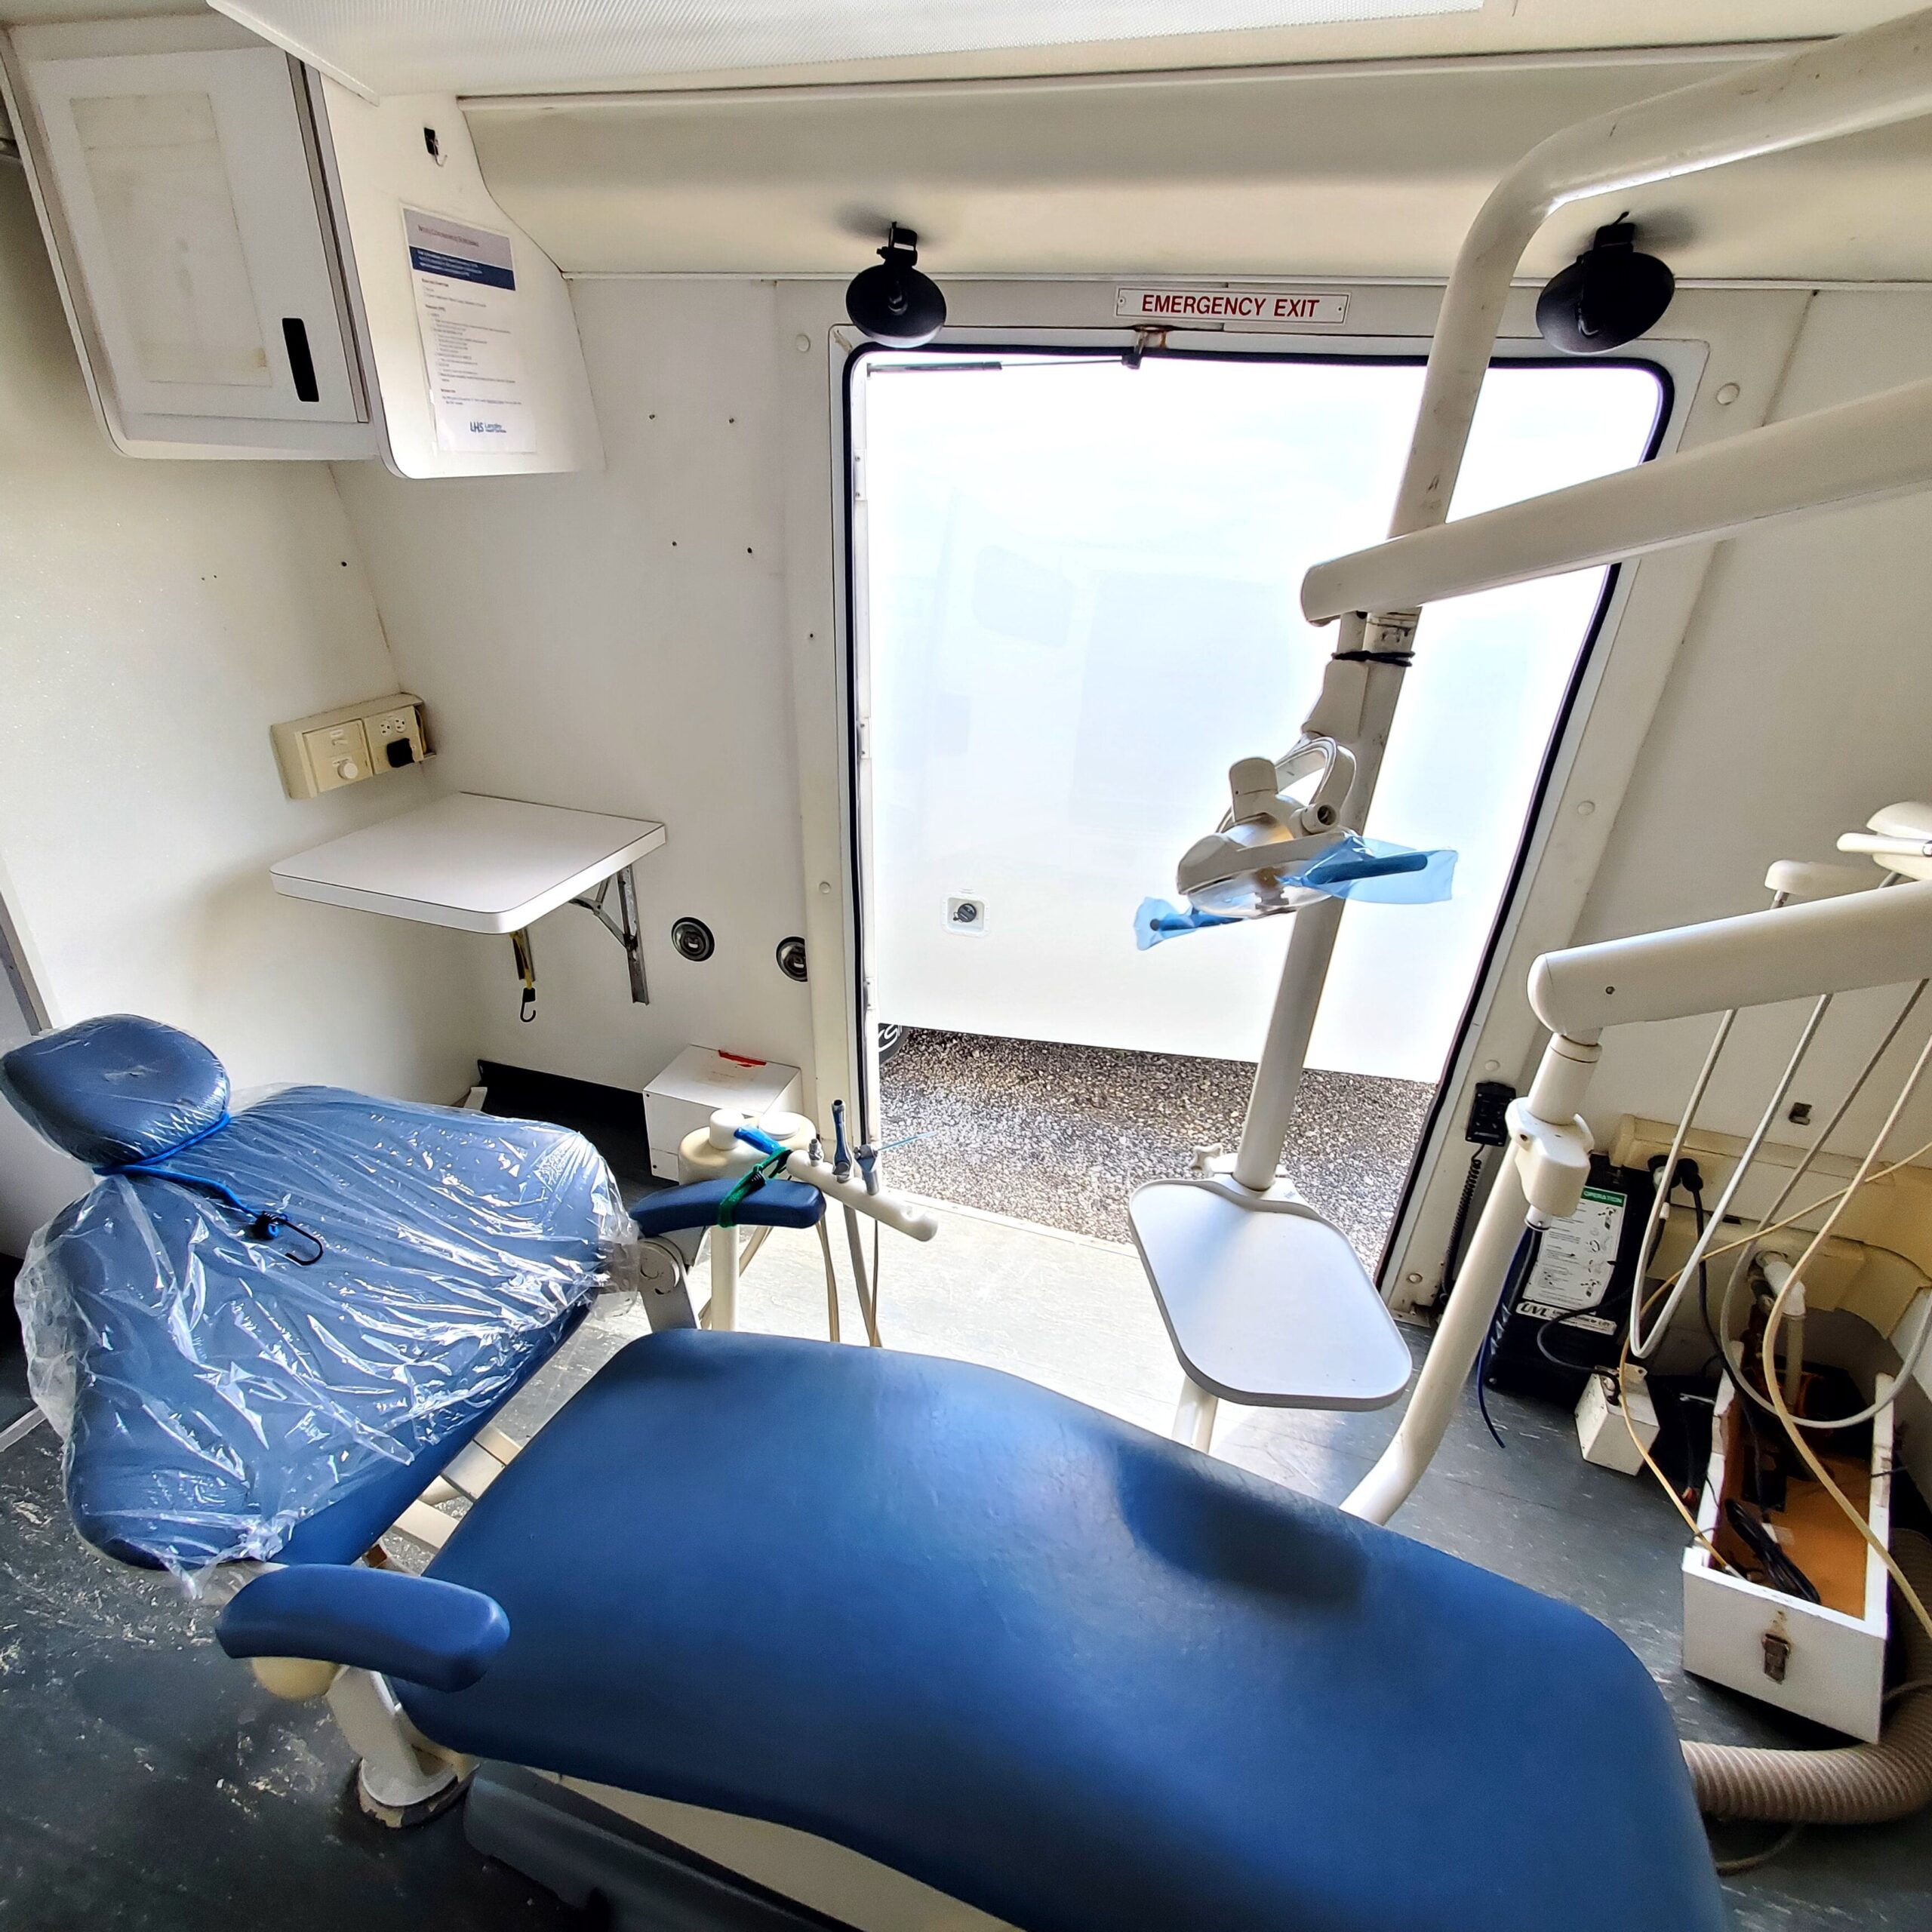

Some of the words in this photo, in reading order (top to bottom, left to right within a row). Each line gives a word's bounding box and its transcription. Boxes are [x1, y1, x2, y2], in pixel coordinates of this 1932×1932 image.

[1142, 294, 1266, 316] EMERGENCY
[1274, 299, 1320, 317] EXIT
[469, 421, 484, 432] LHS
